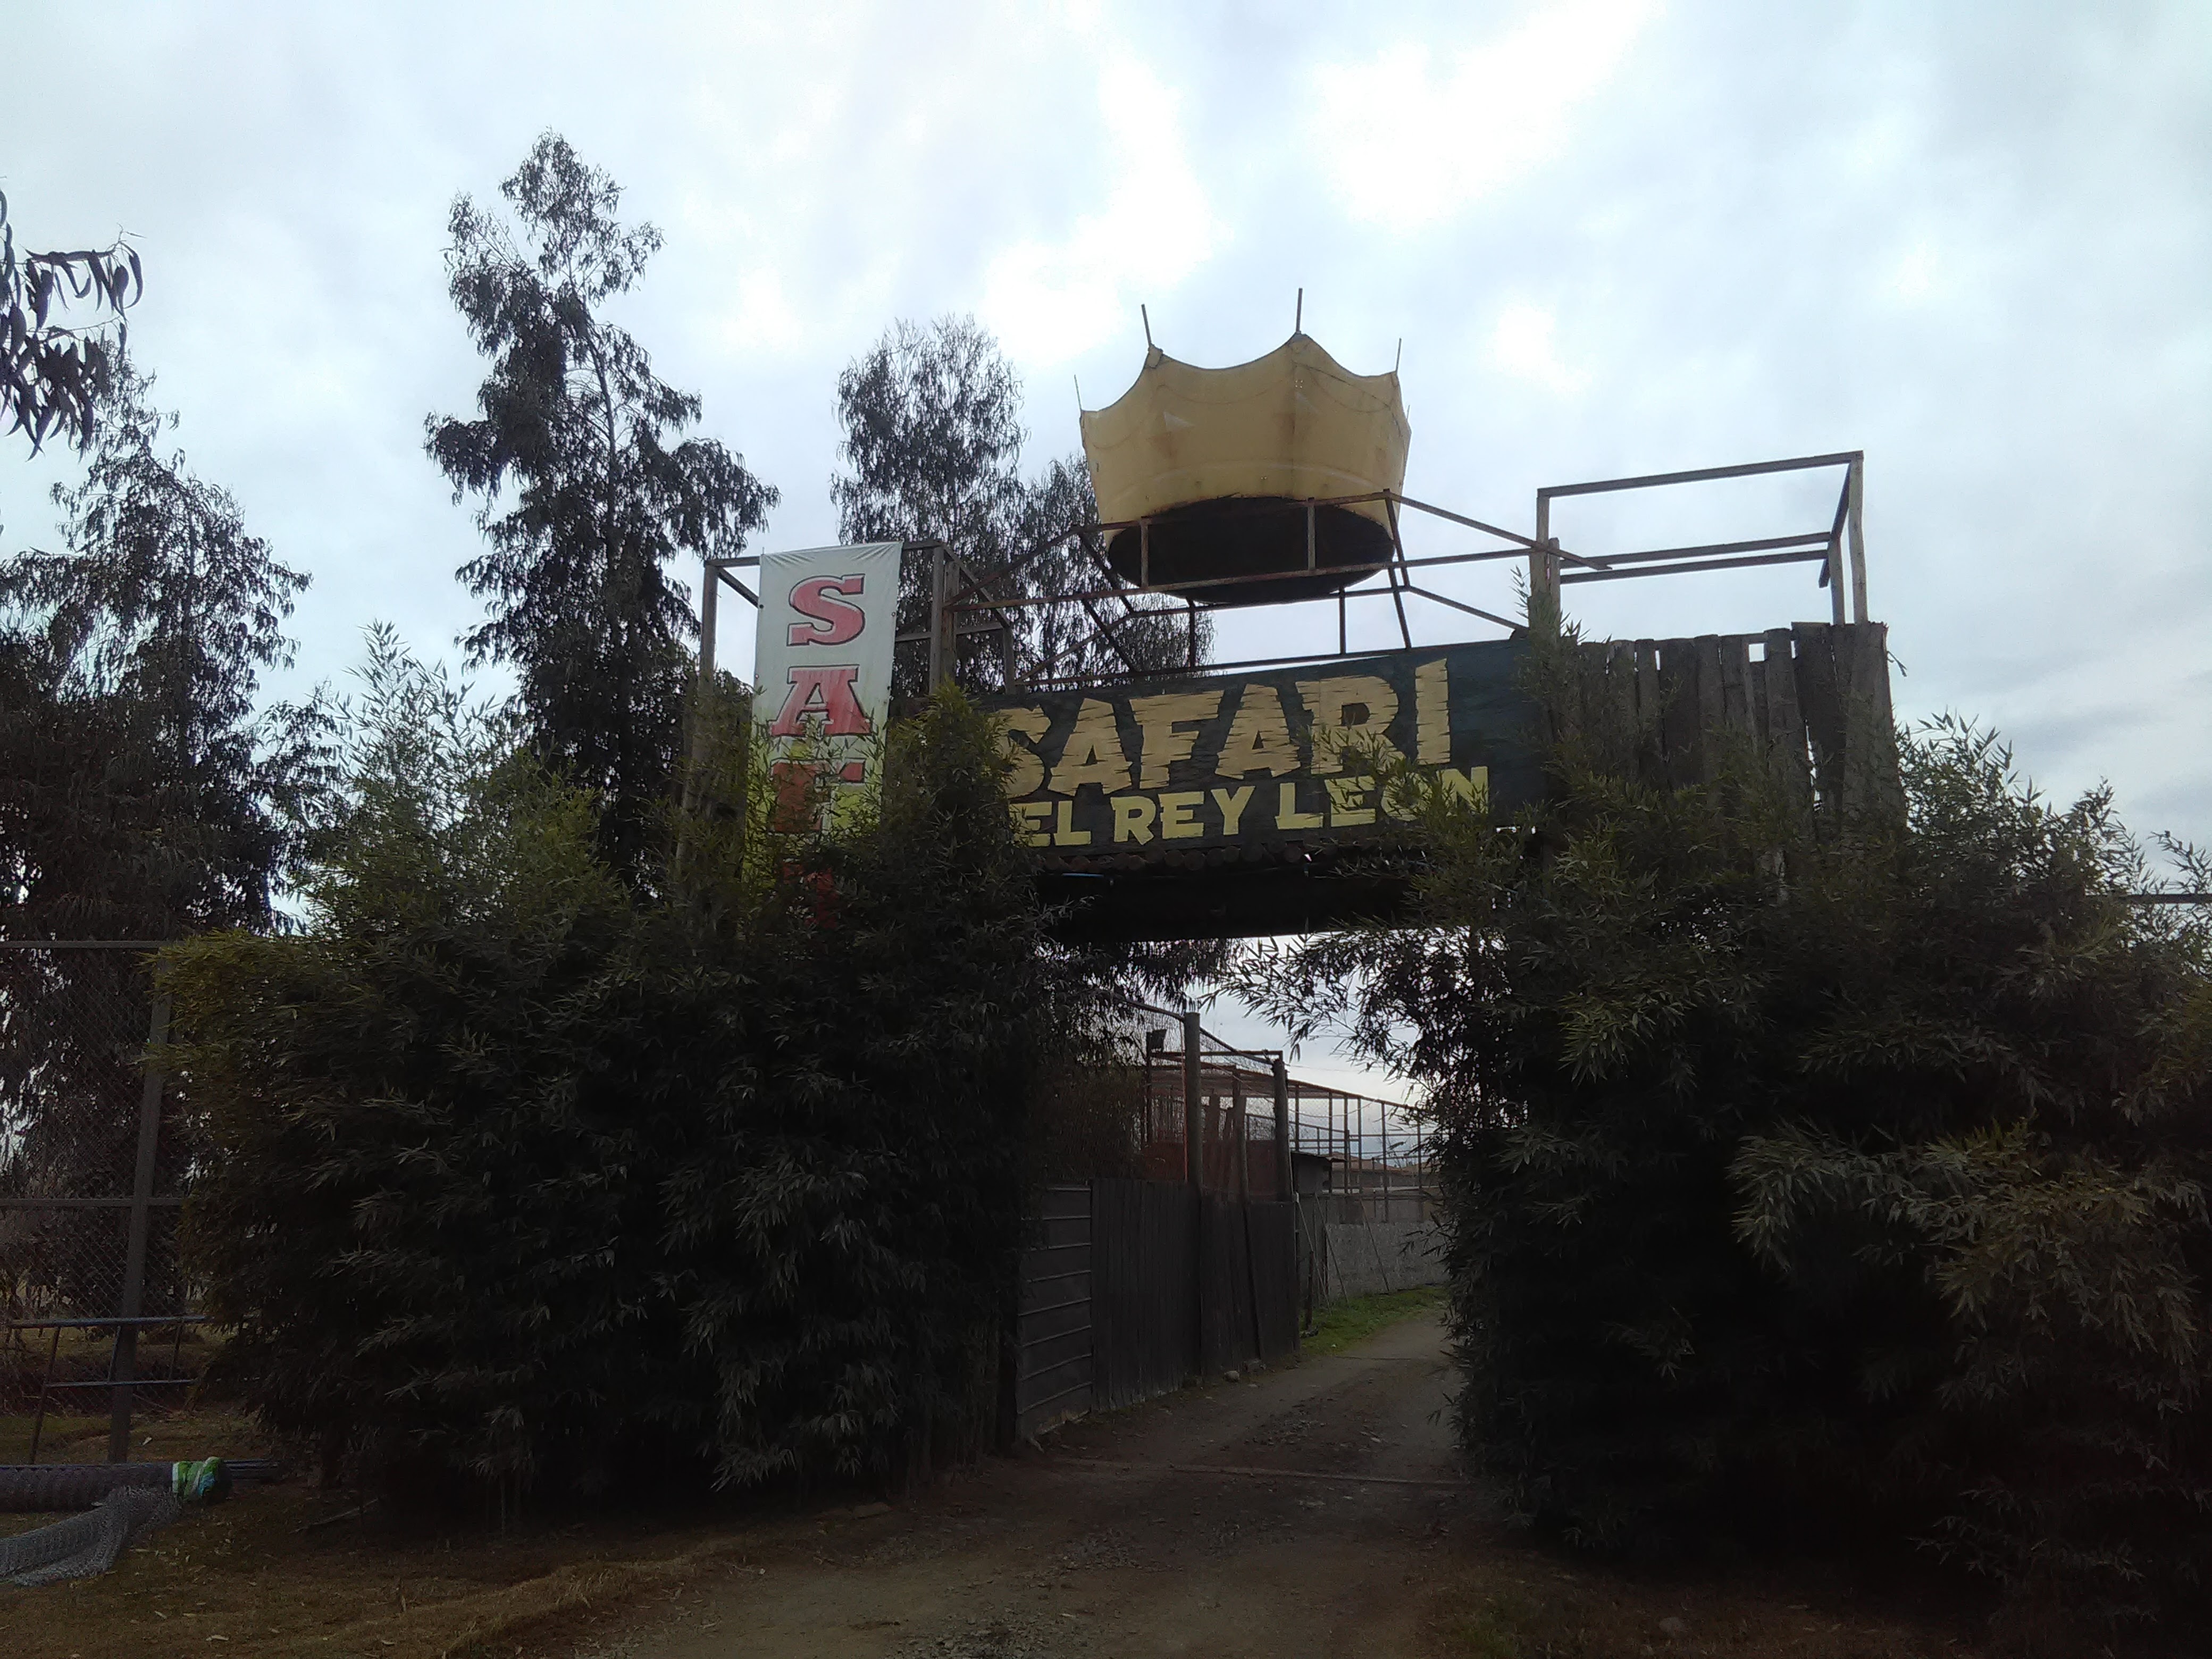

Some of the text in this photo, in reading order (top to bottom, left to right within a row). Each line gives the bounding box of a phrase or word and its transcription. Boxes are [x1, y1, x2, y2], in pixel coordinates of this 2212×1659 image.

[992, 658, 1451, 799] SAFARI
[1009, 766, 1489, 847] EL REY LEON
